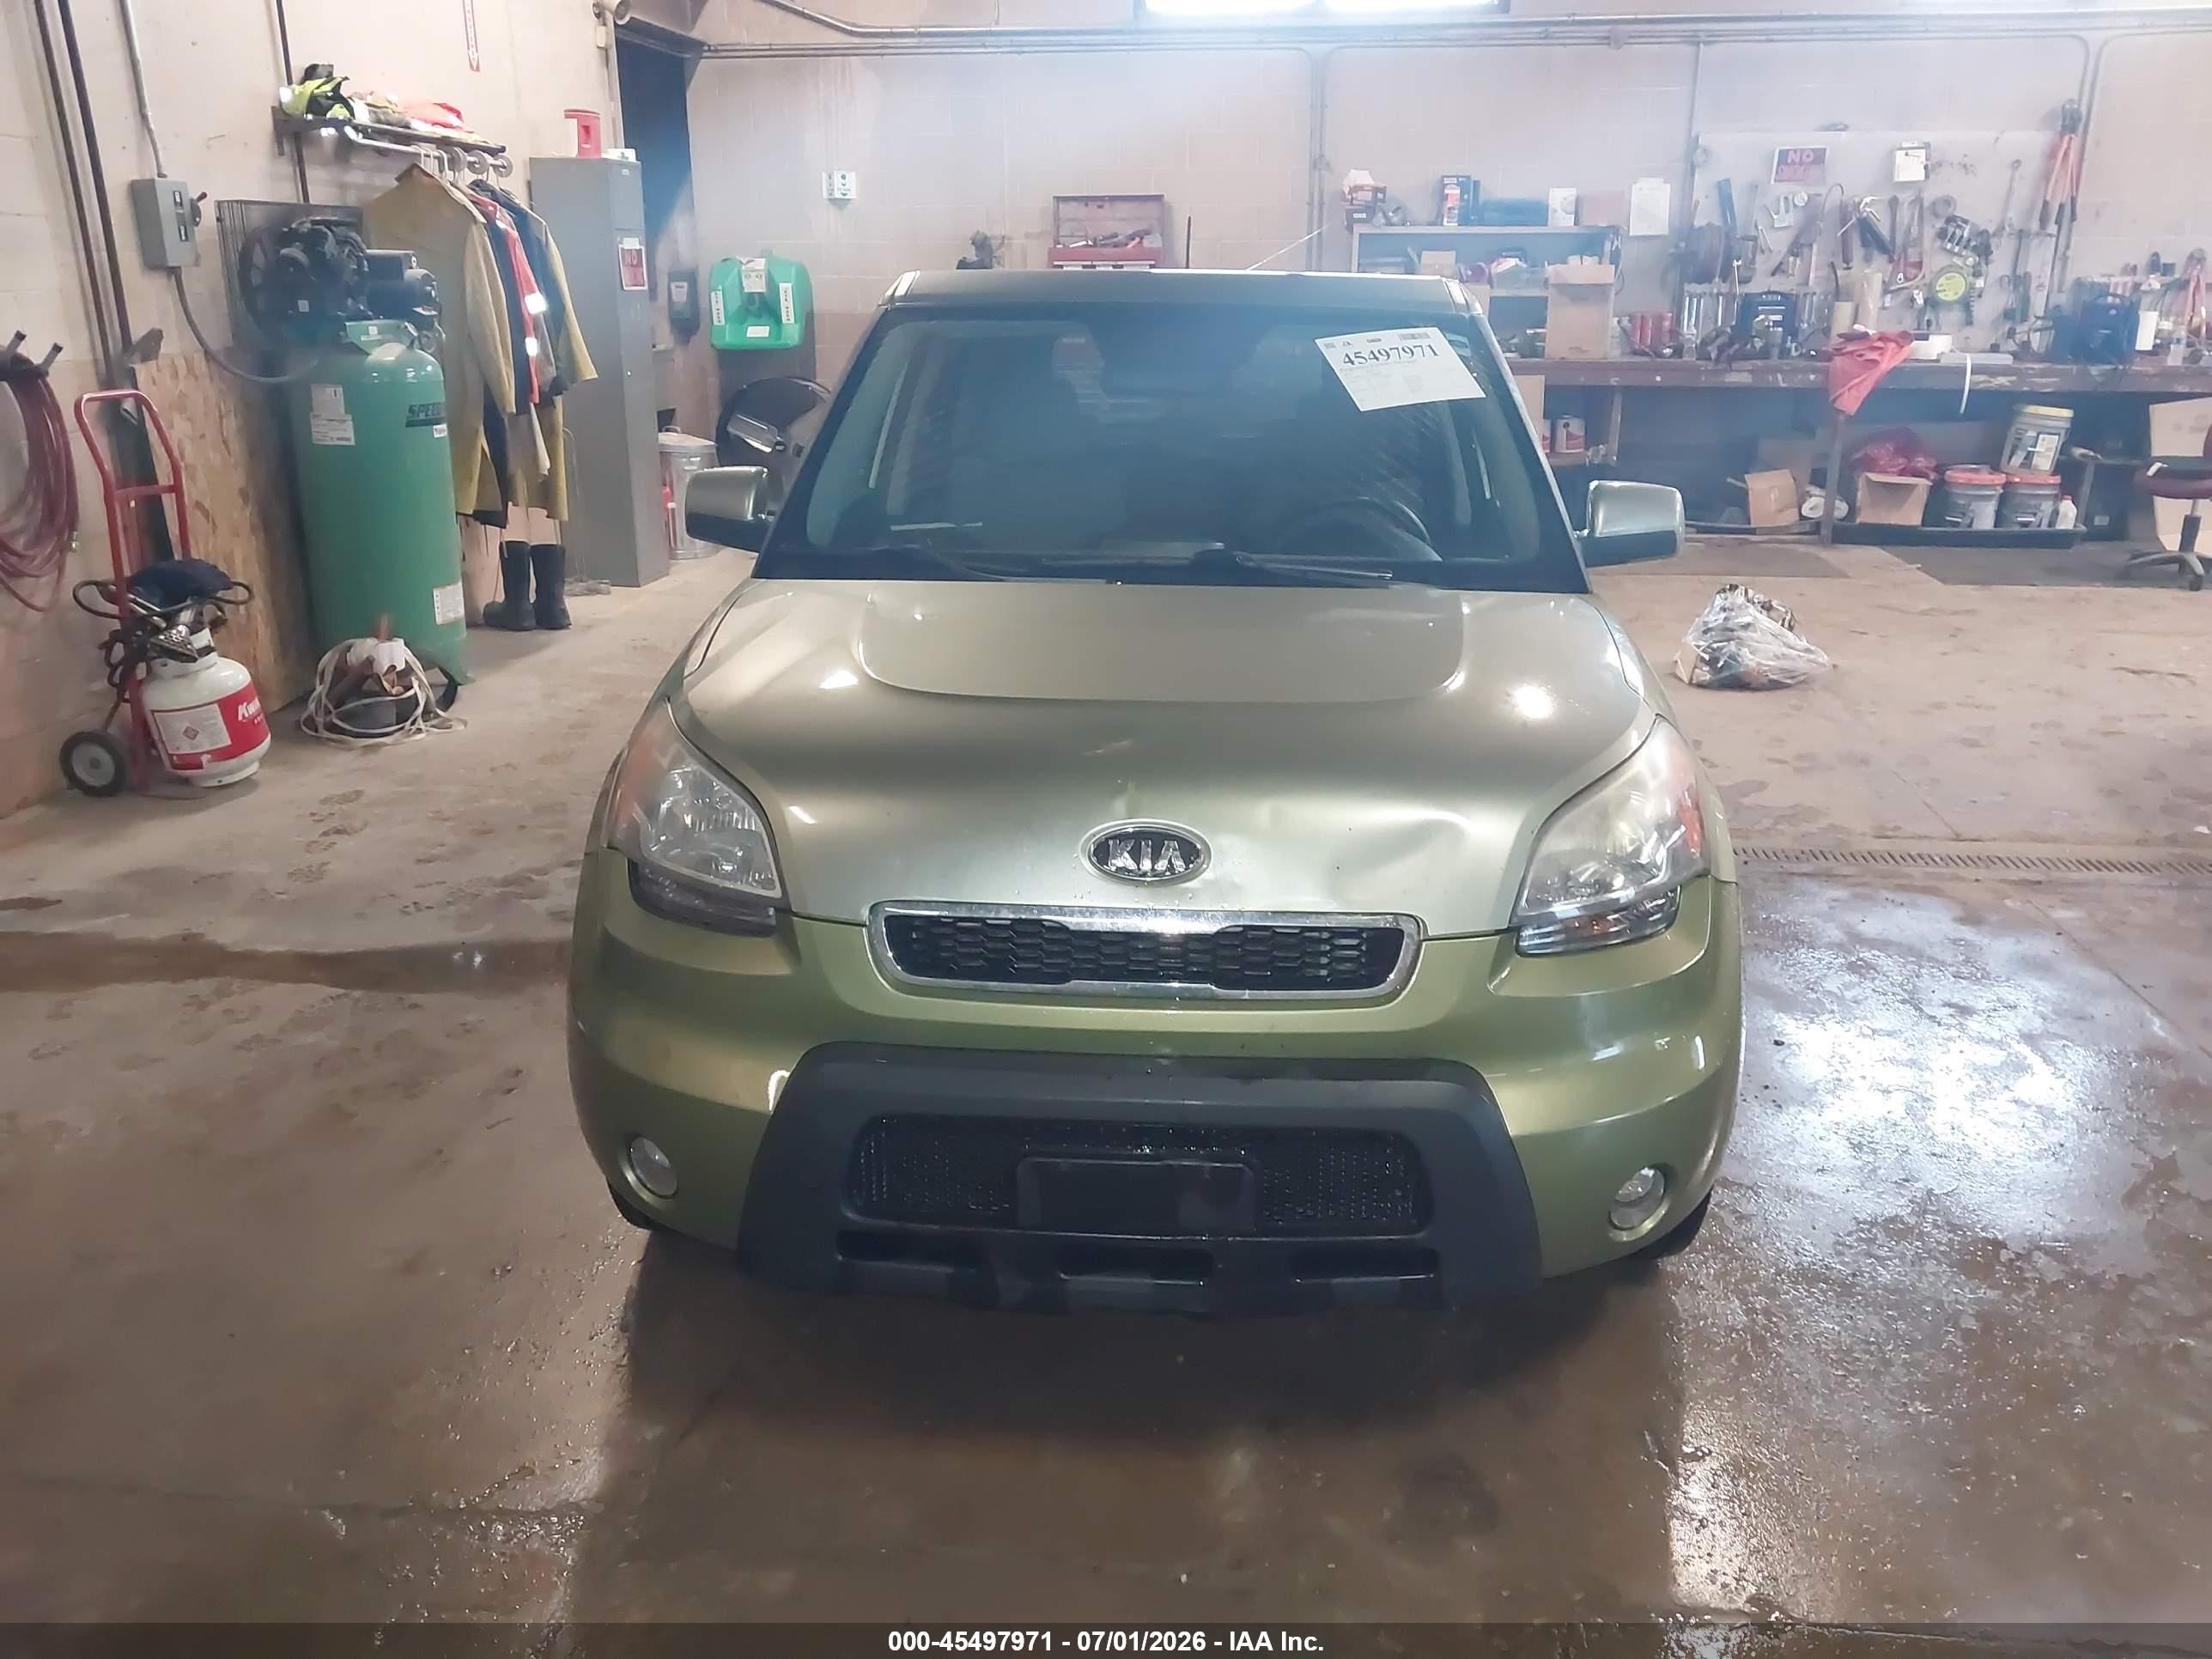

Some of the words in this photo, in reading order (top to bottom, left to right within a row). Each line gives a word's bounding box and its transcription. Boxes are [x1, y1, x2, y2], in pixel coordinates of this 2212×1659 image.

[1787, 149, 1814, 164] NO
[1342, 343, 1441, 366] 45497971
[1108, 839, 1187, 872] KIA
